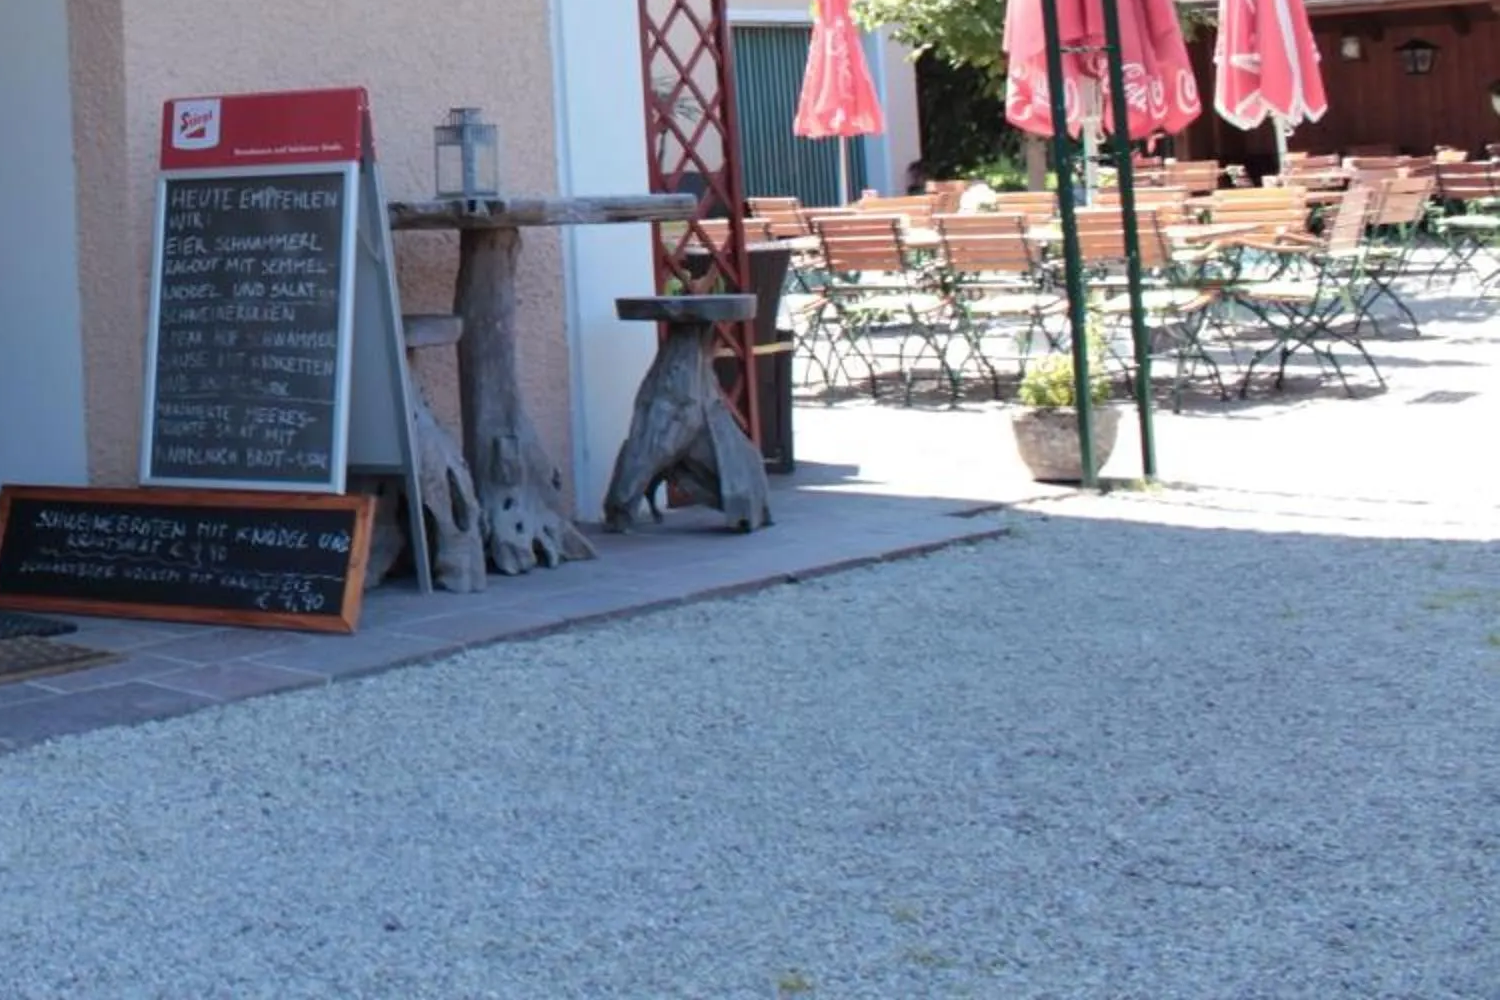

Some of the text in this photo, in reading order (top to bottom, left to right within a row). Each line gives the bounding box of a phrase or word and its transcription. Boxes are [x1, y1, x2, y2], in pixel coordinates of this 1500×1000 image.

[171, 186, 337, 211] HEUTE EMPFEHLEN
[224, 257, 255, 275] MIT
[232, 281, 265, 299] UND
[269, 280, 316, 299] SALAT
